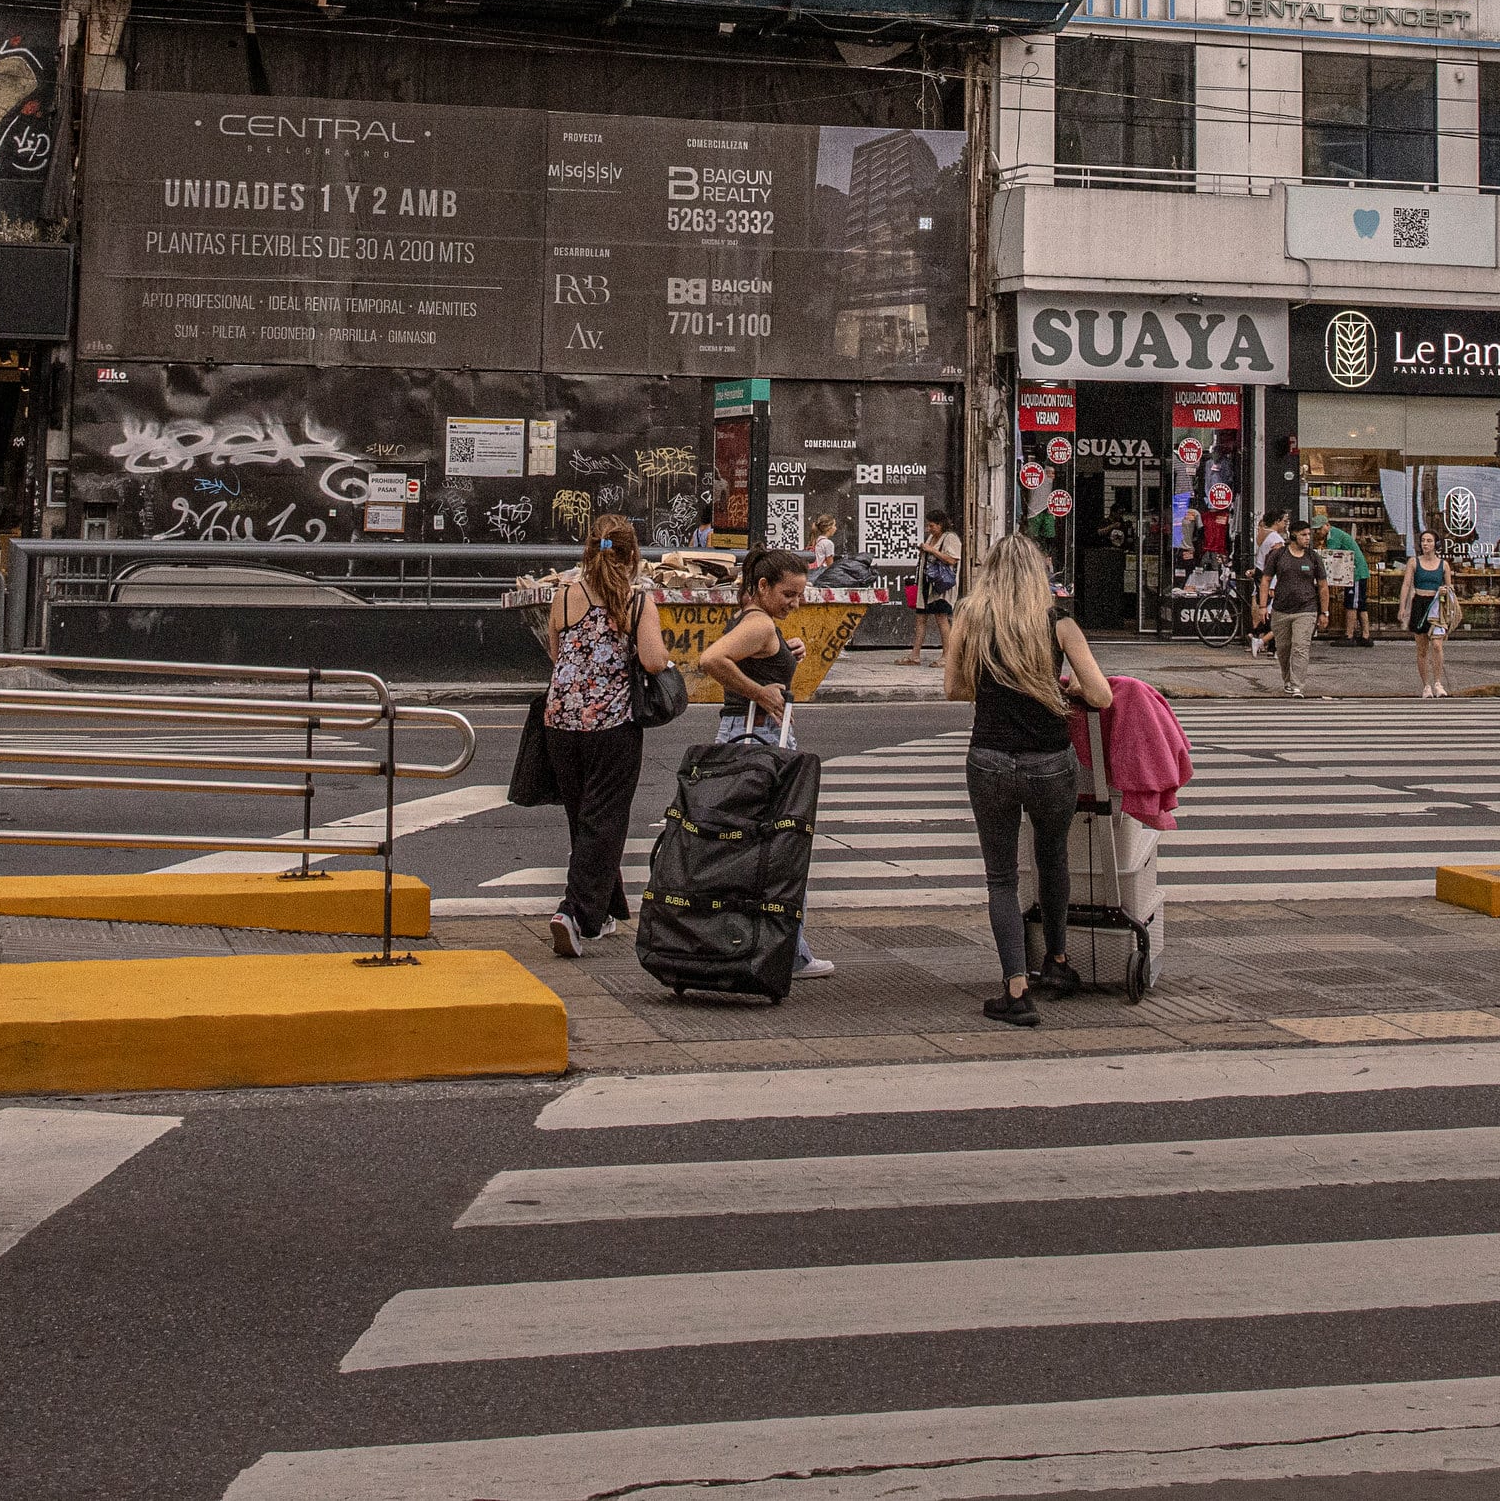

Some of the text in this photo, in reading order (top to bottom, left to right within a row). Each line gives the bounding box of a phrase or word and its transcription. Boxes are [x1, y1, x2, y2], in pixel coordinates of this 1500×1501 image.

[1341, 3, 1472, 29] CONCEPT
[219, 114, 416, 144] CENTRAL
[562, 132, 603, 144] PROYECTA
[686, 138, 749, 150] COMERCIALIZAN
[246, 144, 390, 159] BELGRANO
[702, 168, 773, 186] BAIGUN
[164, 178, 458, 218] UNIDADES 1 Y 2 AMB
[702, 186, 773, 204] REALTY
[667, 207, 775, 235] 5263-3332
[145, 230, 476, 265] PLANTAS FLEXIBLES DE 30 A 200 MTS
[553, 246, 611, 259] DESARROLLAN
[711, 277, 773, 294] BAIGÚN
[141, 293, 478, 318] APTO PROFESIONAL IDEAL RENTA TEMPORAL AMENITIES
[668, 311, 772, 337] 7701-1100
[174, 324, 437, 345] SUM PILETA FOGONERO PARRILLA GIMNASIO
[1030, 307, 1275, 372] SUAYA
[1394, 331, 1436, 365] Le
[1021, 394, 1073, 407] LIQUIDACION TOTAL
[1175, 391, 1238, 407] LIQUIDACION TOTAL
[1035, 410, 1060, 425] VERANO
[1192, 408, 1221, 423] VERANO
[804, 440, 857, 449] COMERCIALIZAN
[1077, 438, 1154, 457] SUAYA
[767, 462, 807, 474] AIGUN
[885, 462, 927, 475] BAIGÚN
[767, 474, 806, 487] EALTY
[1444, 538, 1495, 554] Panem
[1180, 609, 1233, 623] SUAYA
[664, 895, 691, 908] BUBBA
